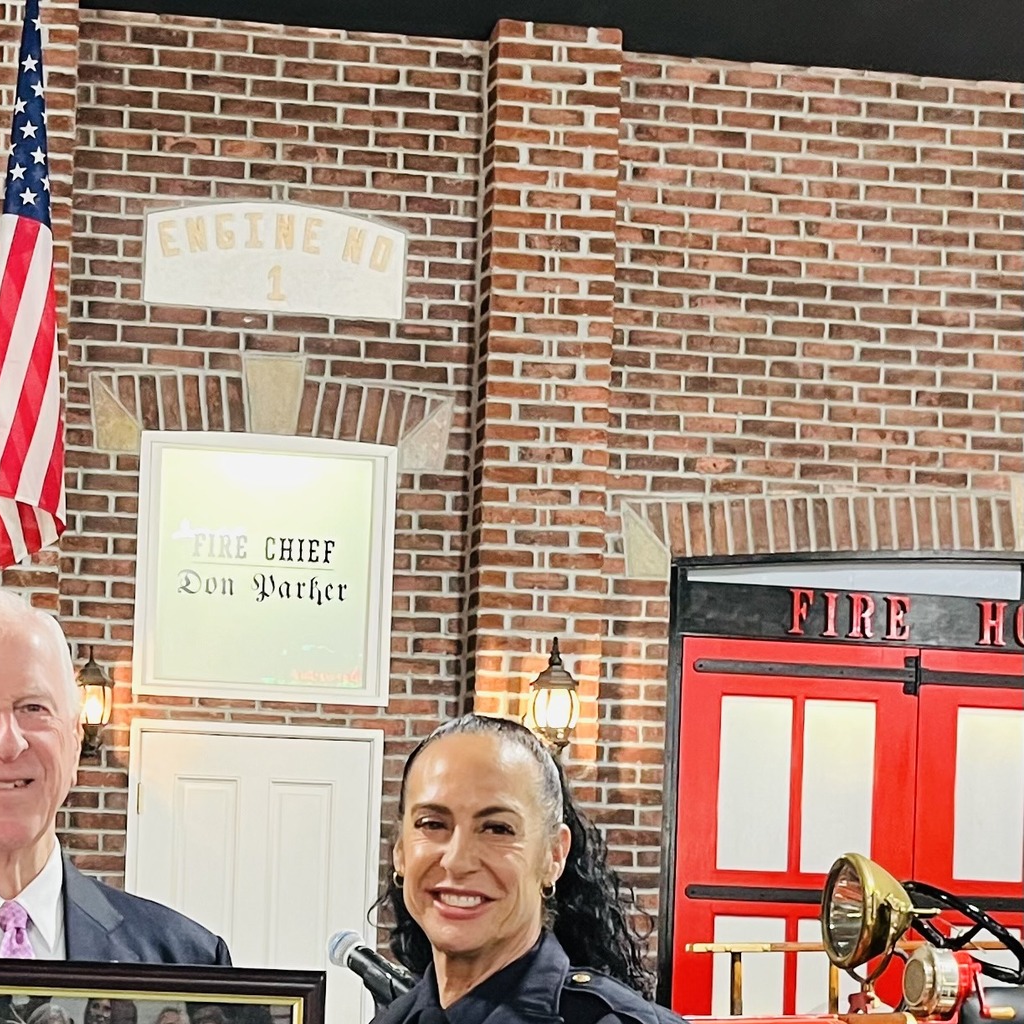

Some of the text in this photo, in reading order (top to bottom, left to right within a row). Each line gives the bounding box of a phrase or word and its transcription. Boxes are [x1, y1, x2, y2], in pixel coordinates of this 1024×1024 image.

[157, 212, 394, 273] ENGINE NO
[266, 264, 287, 301] 1
[192, 533, 336, 563] FIRE CHIEF
[177, 569, 348, 606] Don Parker
[786, 587, 912, 641] FIRE
